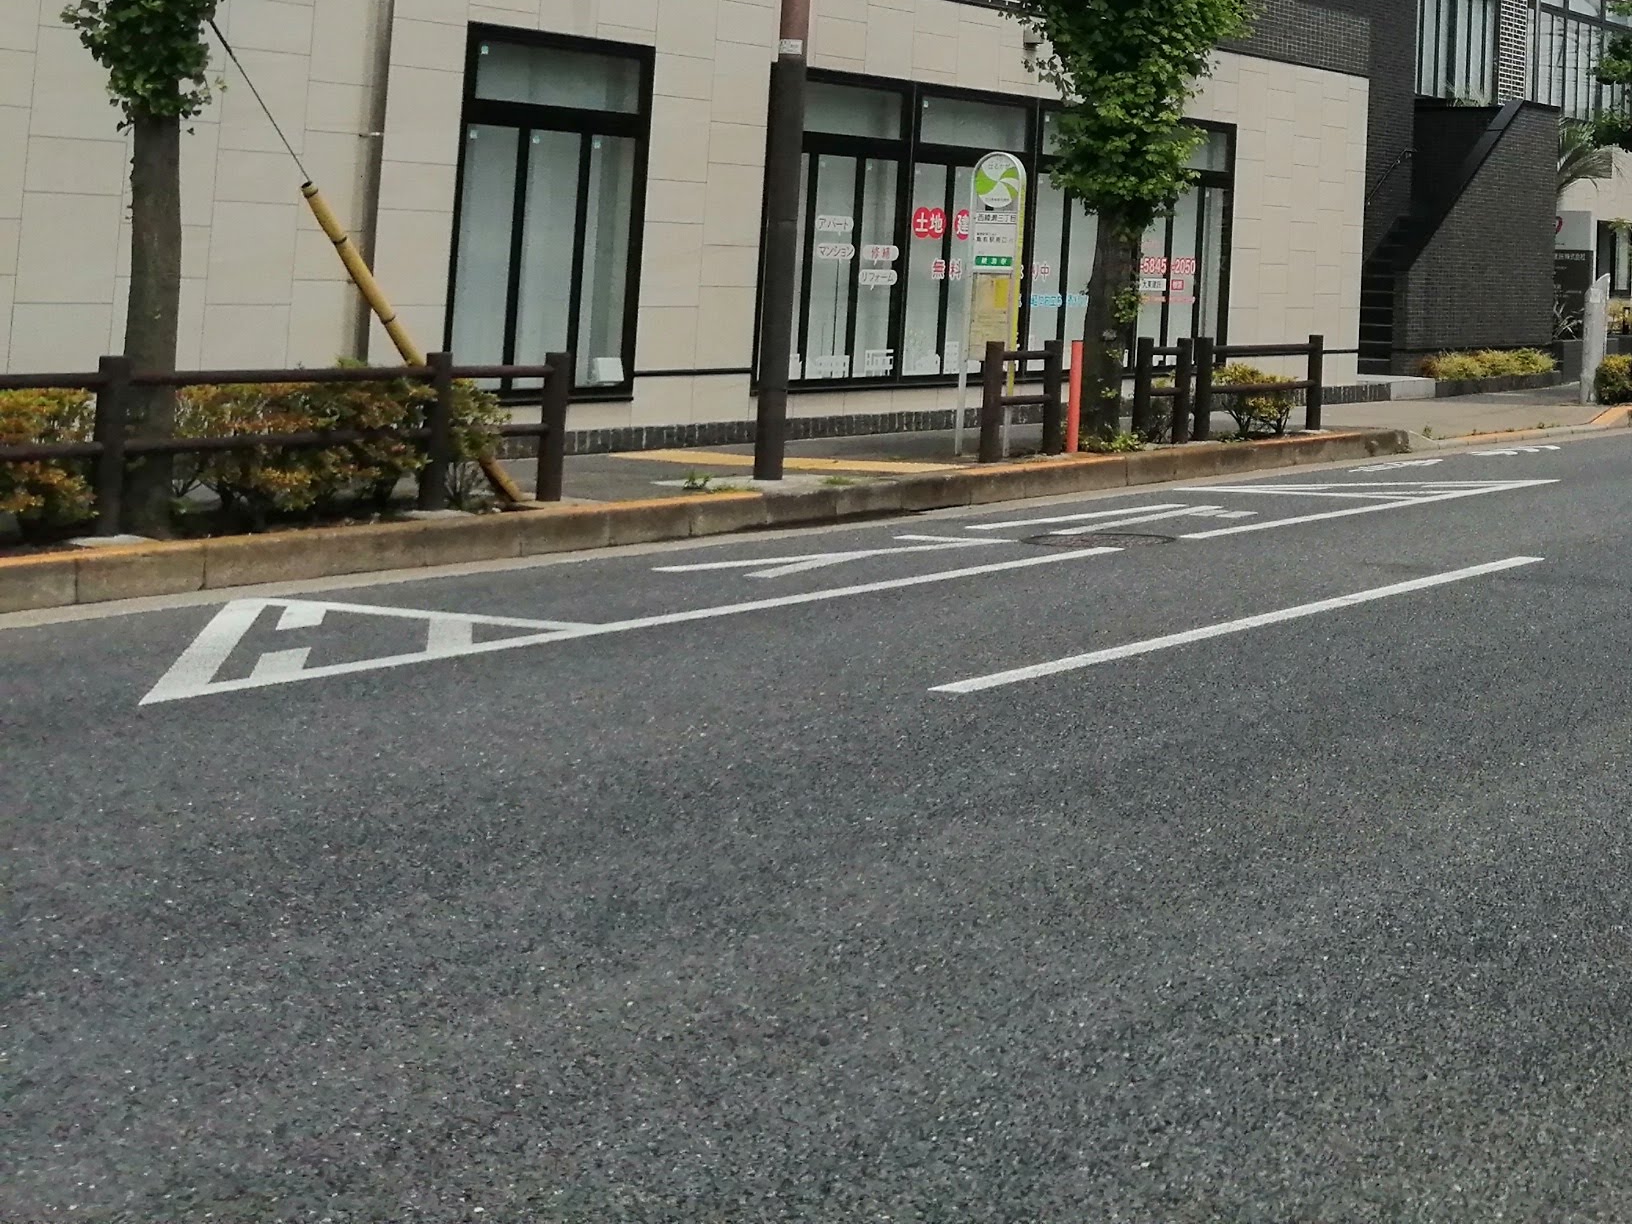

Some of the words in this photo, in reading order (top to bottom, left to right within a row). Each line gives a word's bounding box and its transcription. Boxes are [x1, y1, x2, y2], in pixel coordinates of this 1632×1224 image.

[818, 217, 849, 230] アパート
[914, 212, 944, 234] 土地
[818, 245, 855, 257] マンション
[932, 258, 962, 280] 無料
[862, 271, 896, 283] リフォーム
